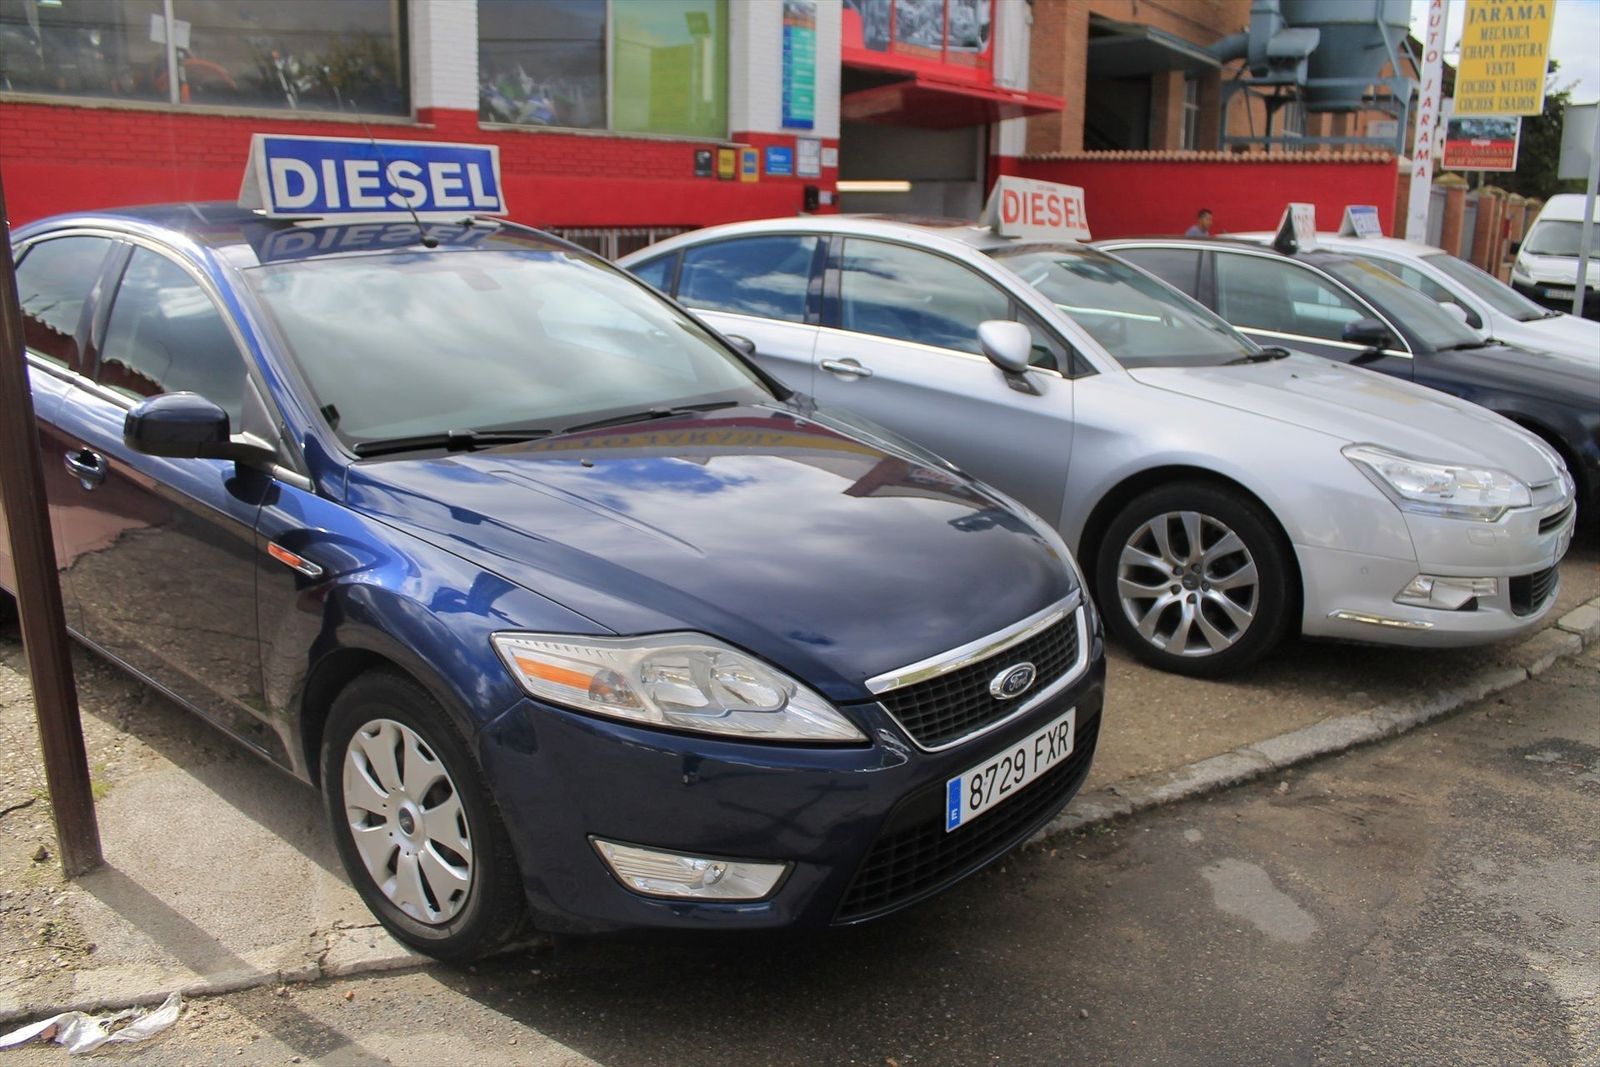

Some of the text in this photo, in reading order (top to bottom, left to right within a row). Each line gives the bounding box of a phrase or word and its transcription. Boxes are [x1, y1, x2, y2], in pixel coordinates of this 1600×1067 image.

[1469, 5, 1546, 24] JARAMA
[1464, 43, 1543, 59] CHAPA PINTURA
[1486, 61, 1516, 76] VENTA
[1415, 0, 1441, 178] AUTO JARAMA
[1461, 78, 1537, 94] COCHES NUEVOS
[1459, 95, 1536, 111] COCHES USADOS
[270, 157, 498, 209] DIESEL
[1002, 189, 1088, 230] DIESEL
[1008, 670, 1030, 692] Ford
[969, 747, 1026, 811] 8729
[1034, 720, 1070, 773] FXR
